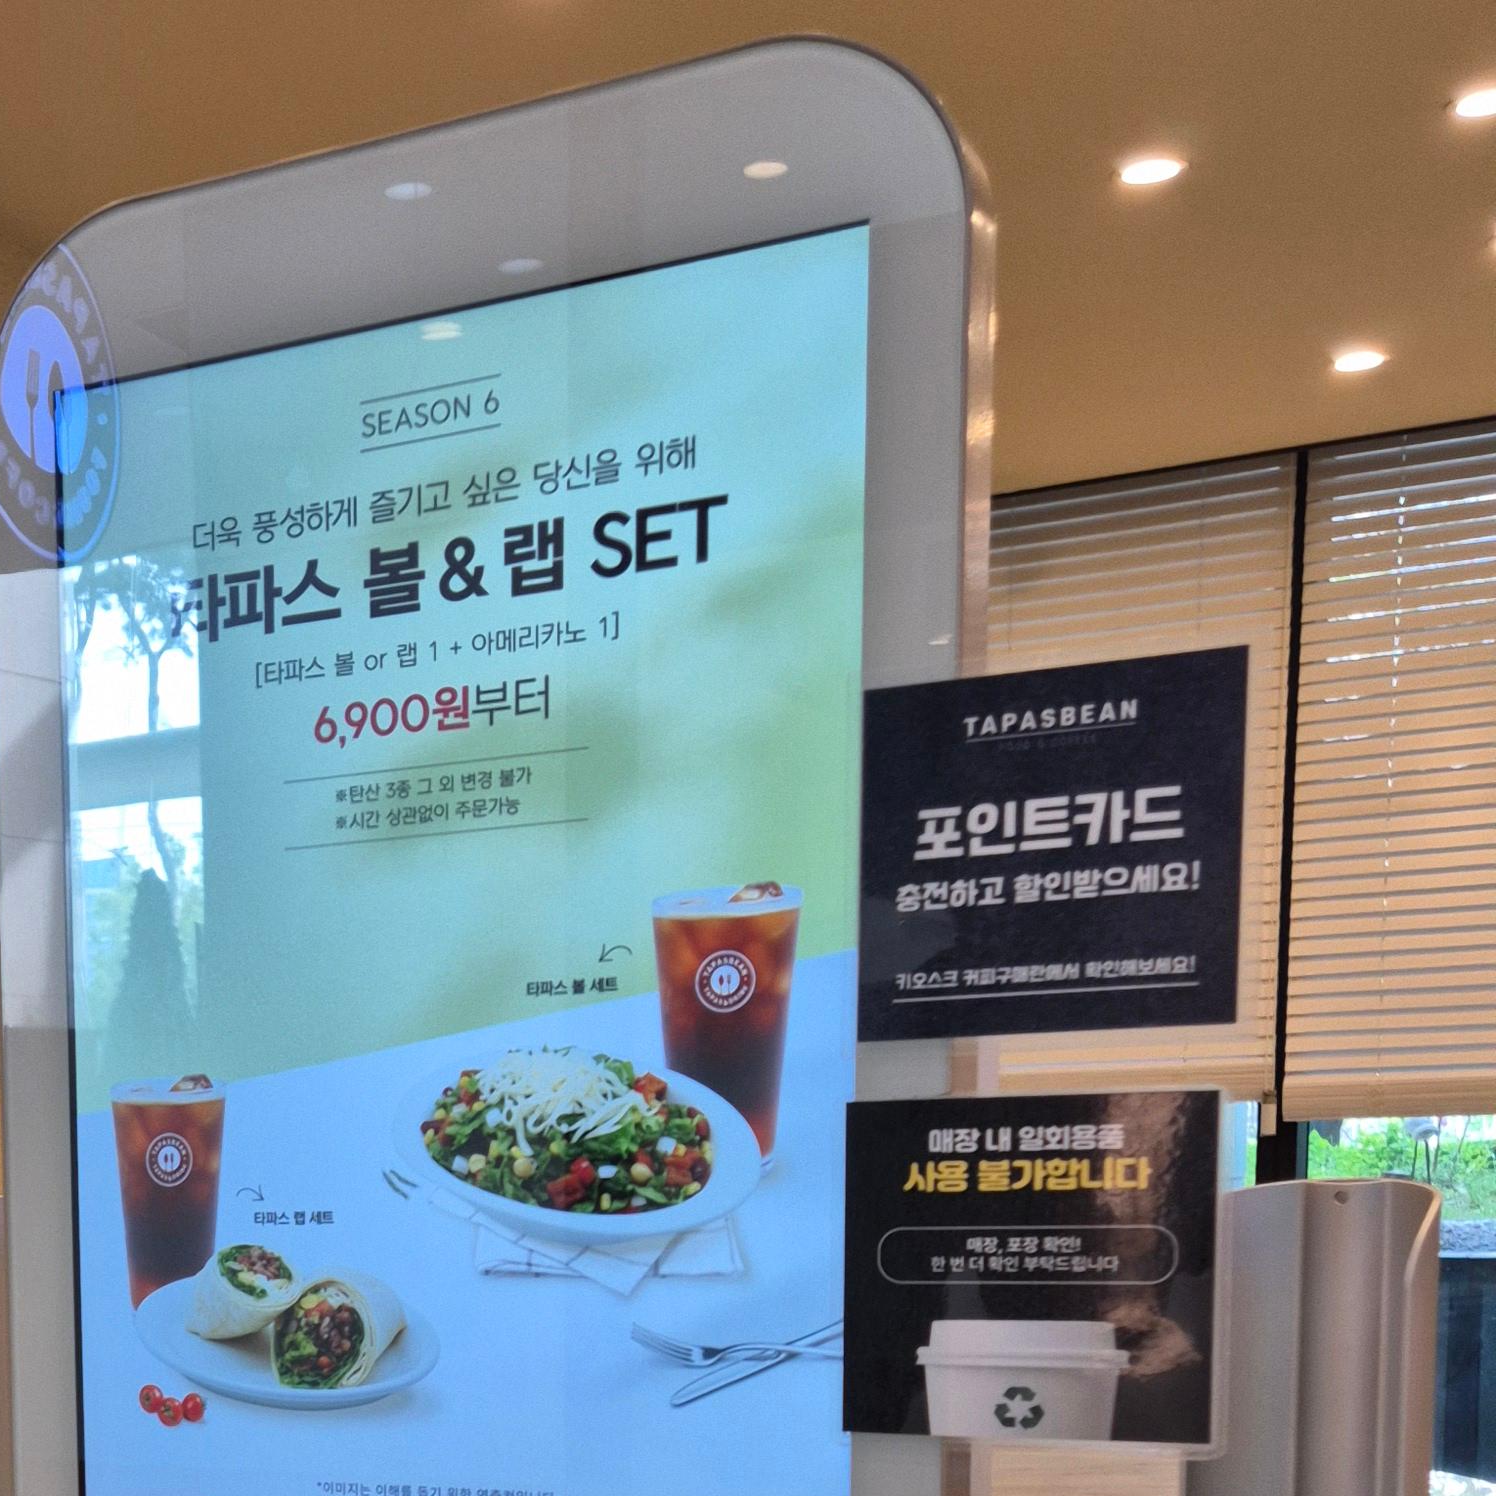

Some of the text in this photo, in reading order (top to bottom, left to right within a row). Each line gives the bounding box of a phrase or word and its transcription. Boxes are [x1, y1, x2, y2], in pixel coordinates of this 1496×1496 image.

[360, 389, 500, 438] SEASON 6
[192, 435, 697, 552] 더욱 풍성하게 즐기고 싶은 당신을 위해
[171, 494, 729, 643] 타파스 볼 & 랩 SET
[255, 611, 620, 689] [타파스 볼 or 랩 1 아메리카노 1]
[314, 674, 550, 749] 6,900원부터
[963, 699, 1138, 738] TAPASBEAN
[385, 765, 532, 800] 3종 그 외 변경 불가
[385, 796, 520, 826] 상관없이 주문가능
[913, 785, 1184, 861] 포인트카드
[895, 860, 1201, 913] 충전하고 할인받으세요!
[526, 976, 619, 998] 타파스 볼 세트
[896, 954, 1196, 991] 키오스크 확인해보세요!
[928, 1123, 1126, 1153] 매장 내 일회용품
[902, 1156, 1153, 1193] 사용 불가합니다
[254, 1210, 335, 1226] 타파스 랩 세트
[930, 1254, 1119, 1273] 한 번 더 확인 부탁드립니다
[966, 1235, 1082, 1255] 매장, 포장 확인!
